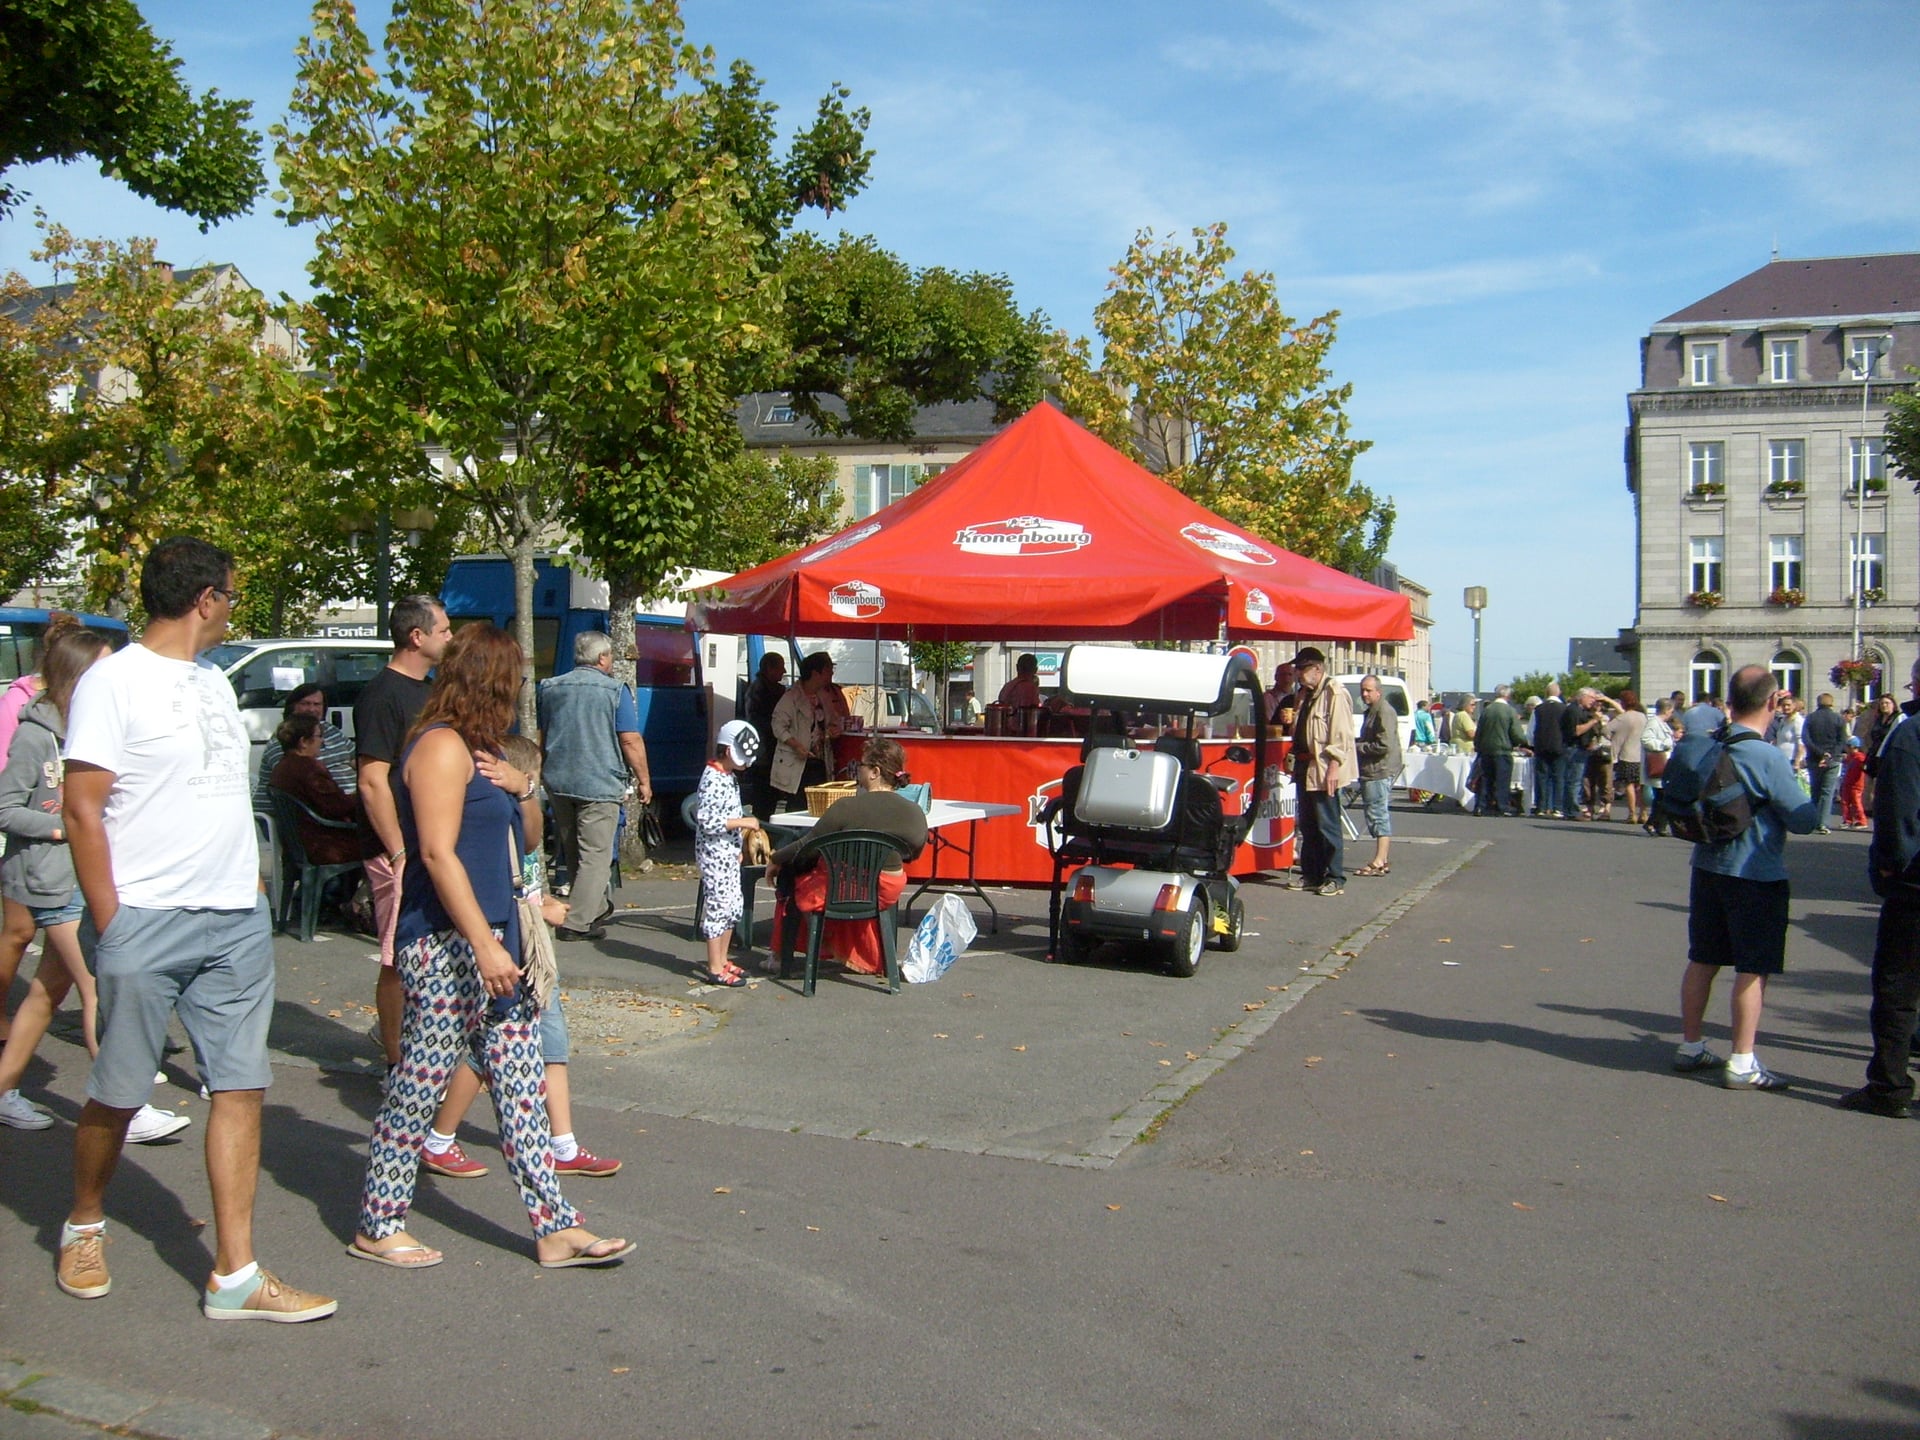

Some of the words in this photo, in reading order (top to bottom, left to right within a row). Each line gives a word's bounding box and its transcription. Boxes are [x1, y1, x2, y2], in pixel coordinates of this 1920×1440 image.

[955, 530, 1091, 547] Kronenbourg
[829, 591, 885, 608] Kronenbourg
[328, 626, 391, 637] Fontai
